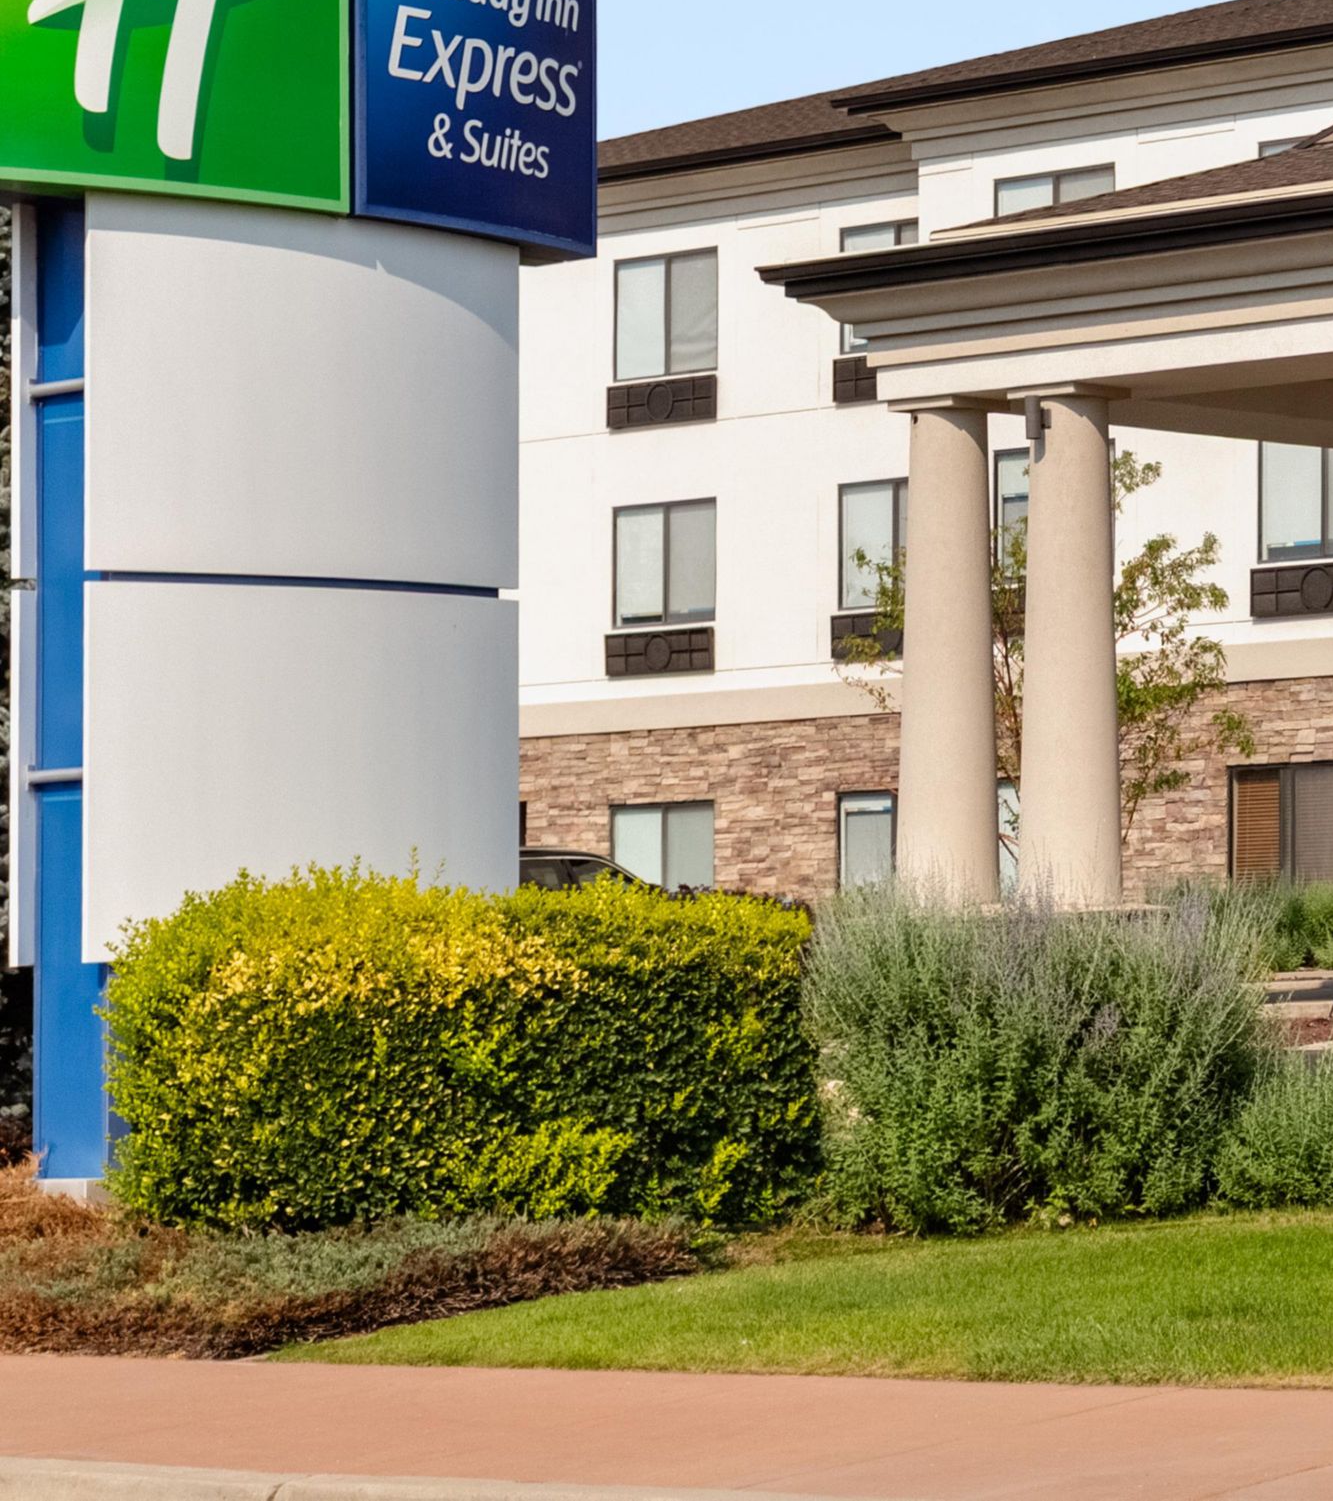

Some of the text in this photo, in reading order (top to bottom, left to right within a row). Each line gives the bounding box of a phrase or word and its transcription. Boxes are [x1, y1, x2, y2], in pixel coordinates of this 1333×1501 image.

[388, 5, 579, 117] Express
[427, 113, 550, 179] & Suites
